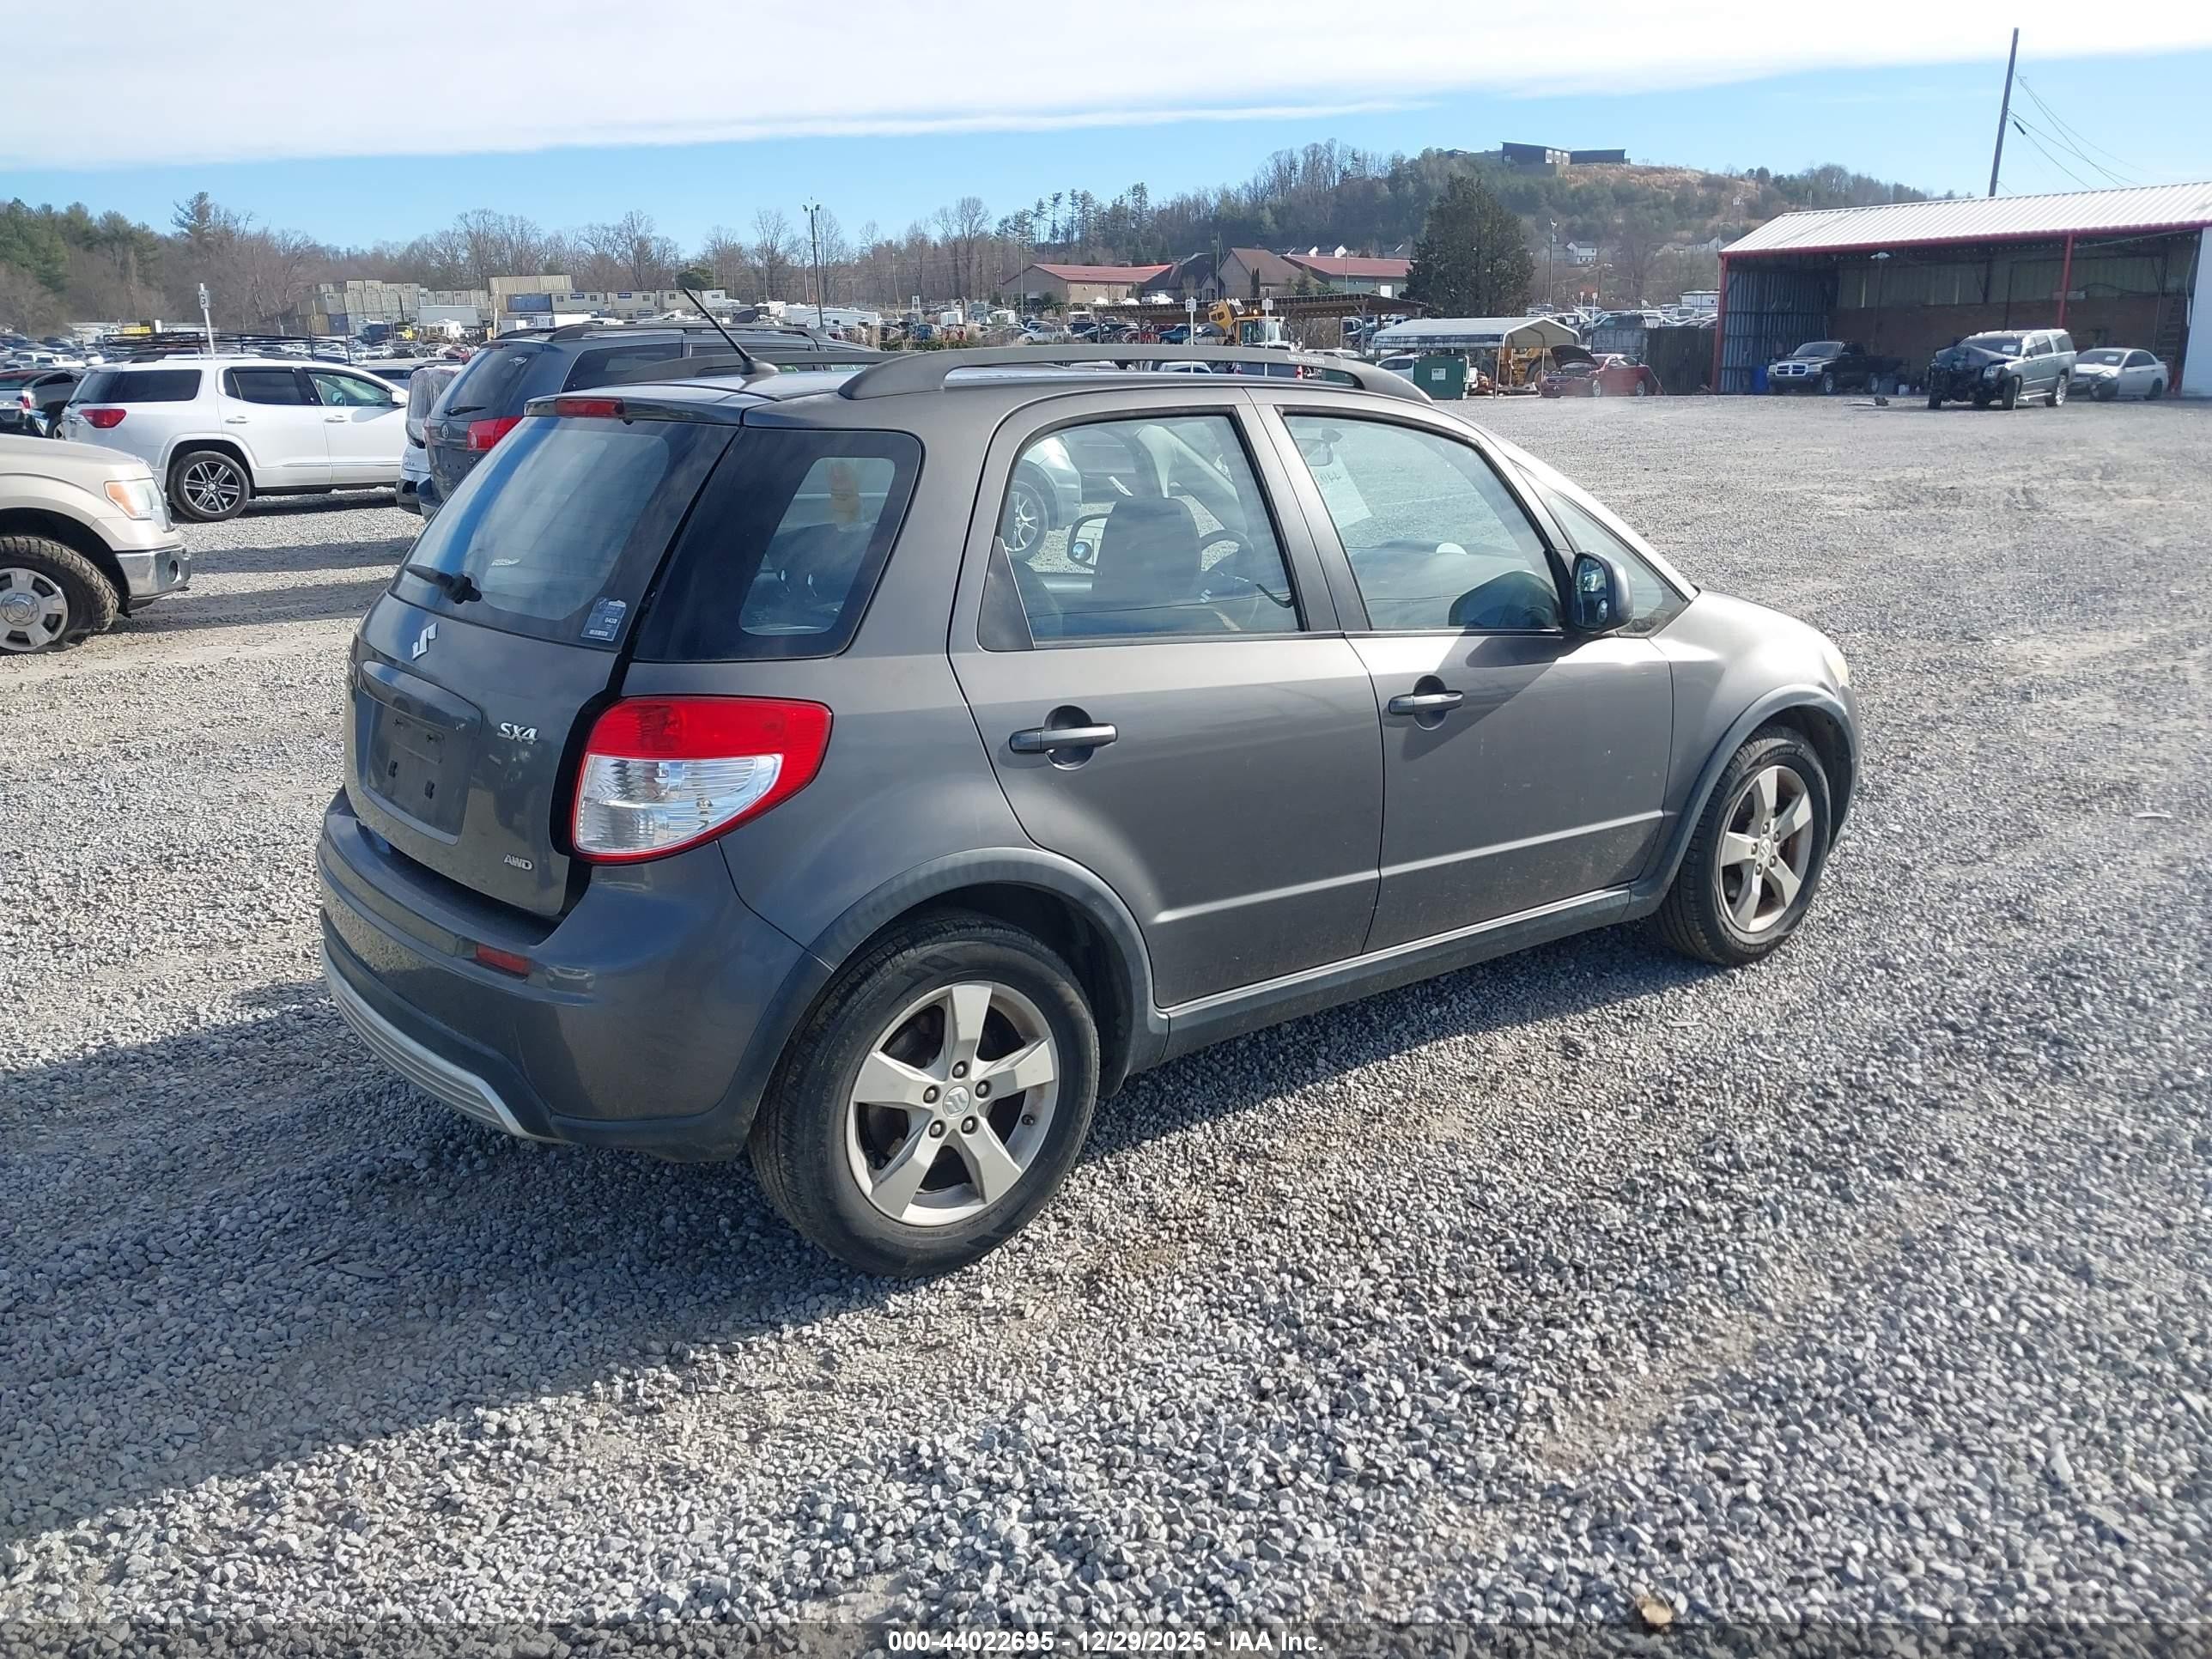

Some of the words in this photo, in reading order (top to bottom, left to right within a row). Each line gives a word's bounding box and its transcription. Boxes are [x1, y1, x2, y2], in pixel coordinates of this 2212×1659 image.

[200, 294, 206, 305] G
[497, 722, 538, 742] SX4
[503, 854, 533, 871] AWD
